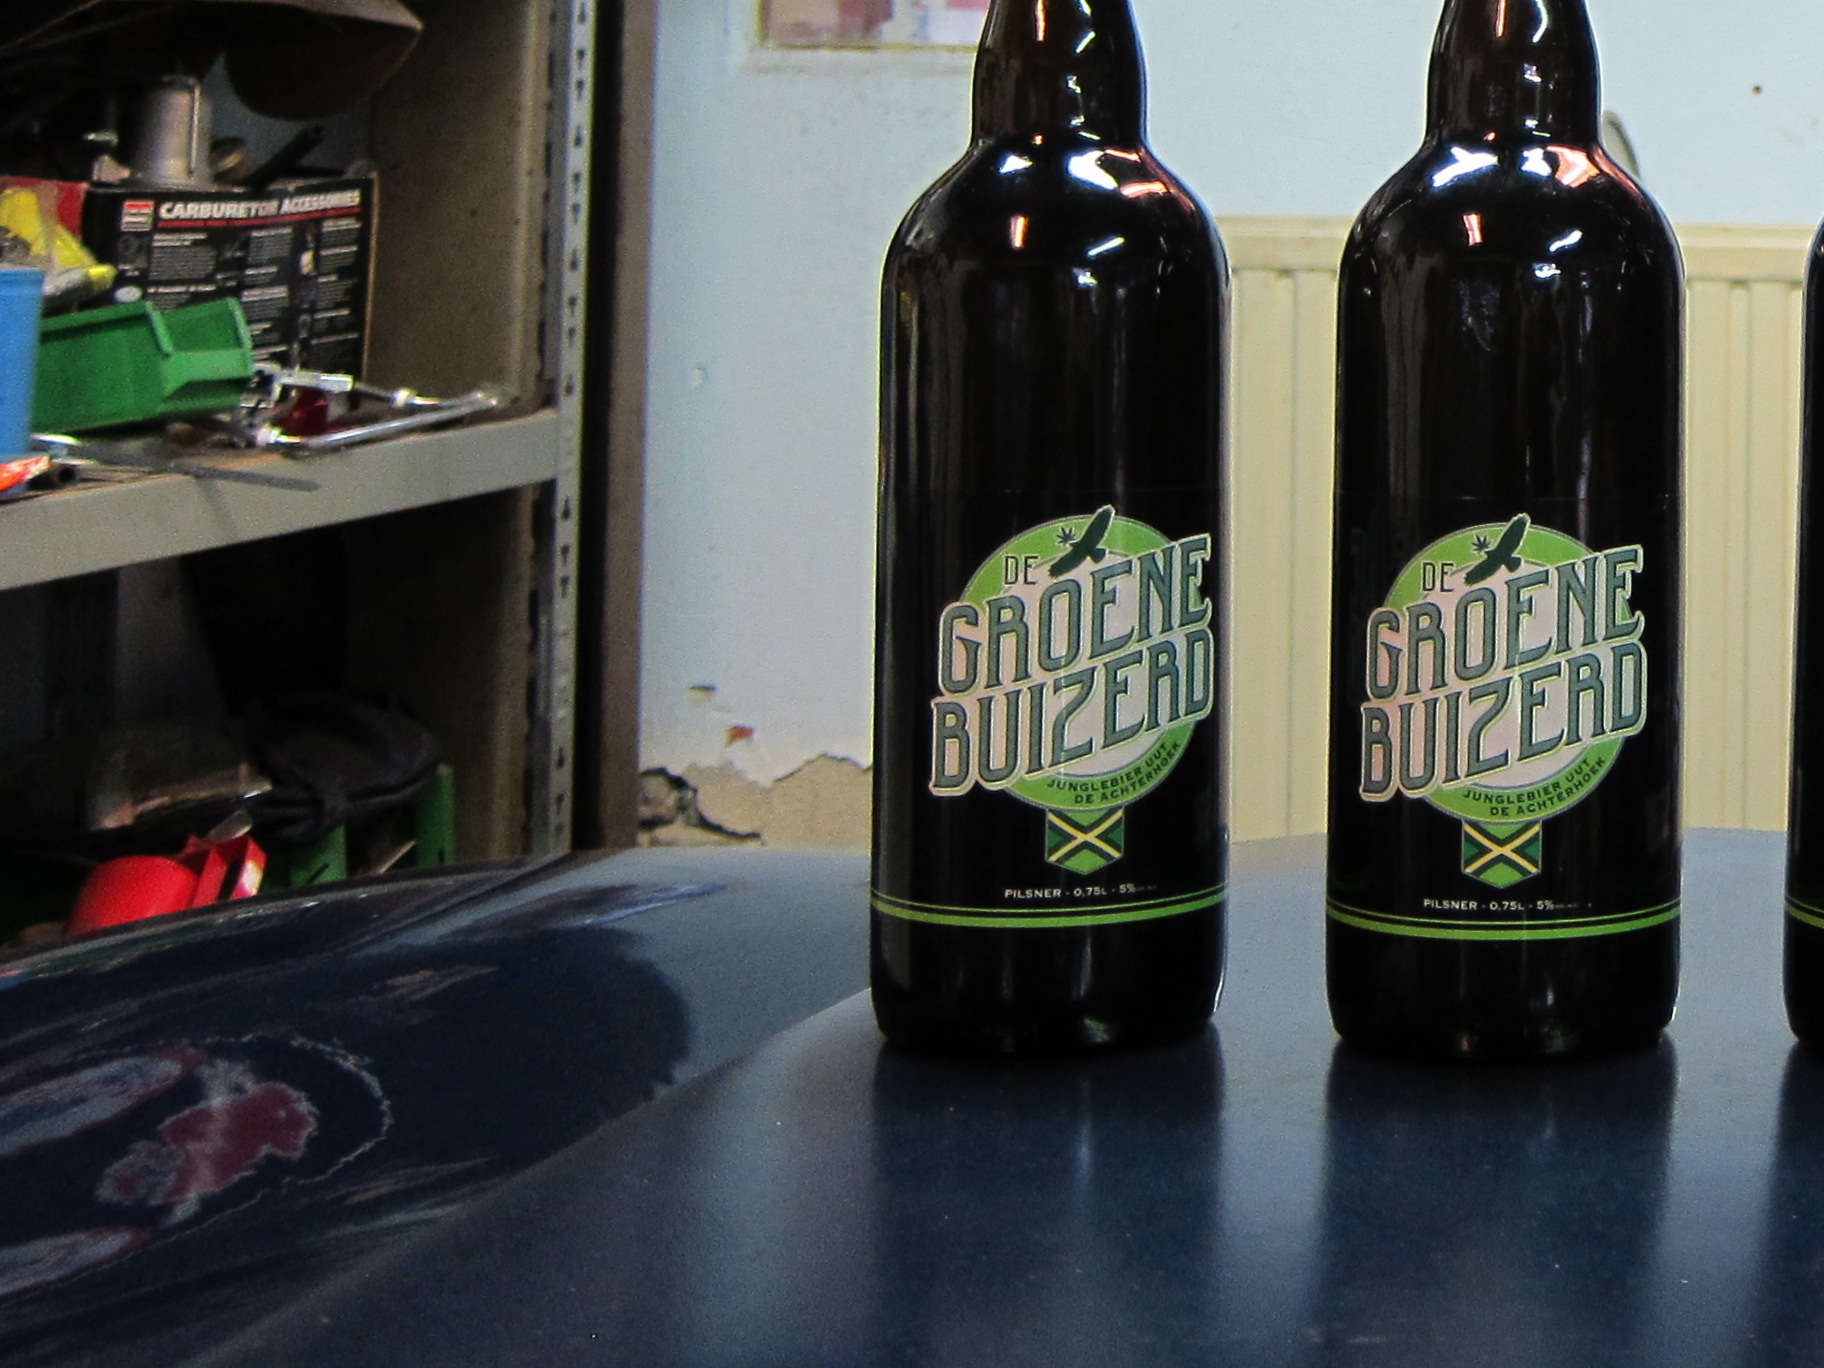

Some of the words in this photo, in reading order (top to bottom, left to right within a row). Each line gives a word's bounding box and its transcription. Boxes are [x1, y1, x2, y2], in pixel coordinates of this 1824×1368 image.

[158, 200, 279, 219] CARBURETOR
[1004, 555, 1039, 586] DE
[1422, 562, 1454, 592] DE
[940, 535, 1211, 695] GROENE
[1368, 547, 1642, 700] GROENE
[932, 628, 1213, 791] BUIZERD
[1362, 643, 1646, 795] BUIZERD
[1047, 767, 1142, 791] JUNGLEBIER
[1145, 742, 1167, 767] UUT
[1074, 794, 1093, 804] DE
[1101, 742, 1181, 802] ACHTERHOEK
[1463, 782, 1561, 804] JUNGLEBIER
[1565, 758, 1590, 783] UUT
[1490, 806, 1509, 817] DE
[1516, 757, 1606, 815] ACHTERHOEK
[1004, 888, 1062, 899] PILSNER
[1424, 899, 1478, 910] PILSNER
